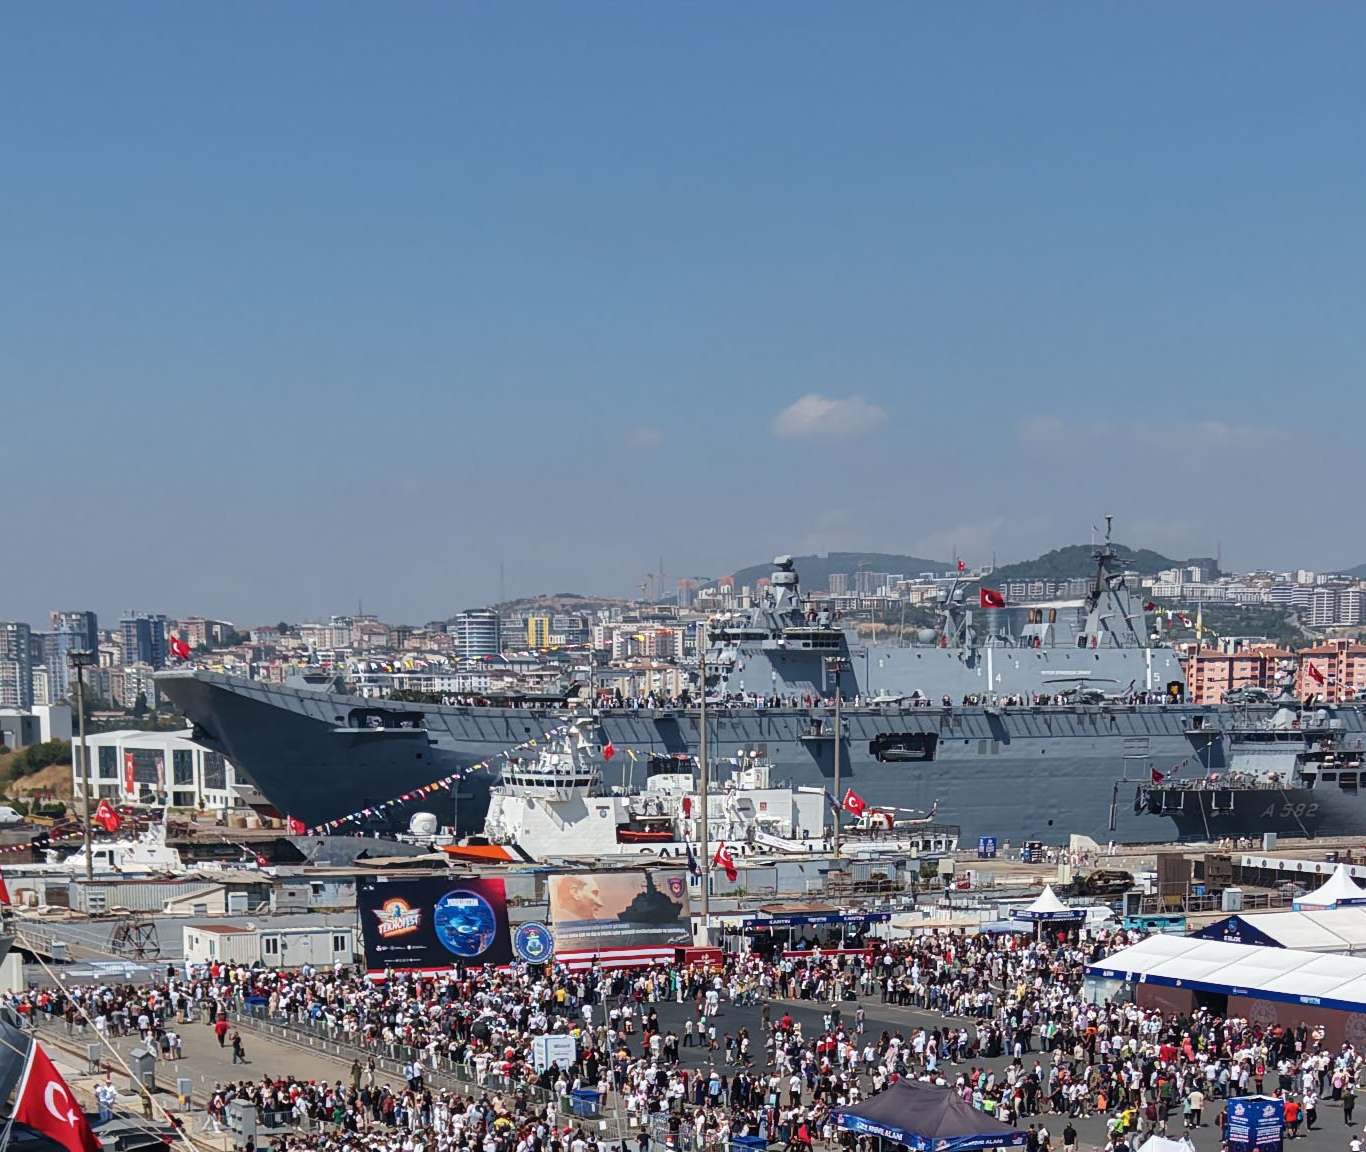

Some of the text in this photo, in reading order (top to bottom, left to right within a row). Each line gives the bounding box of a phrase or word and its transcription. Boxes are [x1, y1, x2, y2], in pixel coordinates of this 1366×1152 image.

[995, 673, 1002, 683] 4
[1153, 673, 1160, 682] 5
[1260, 803, 1275, 818] A
